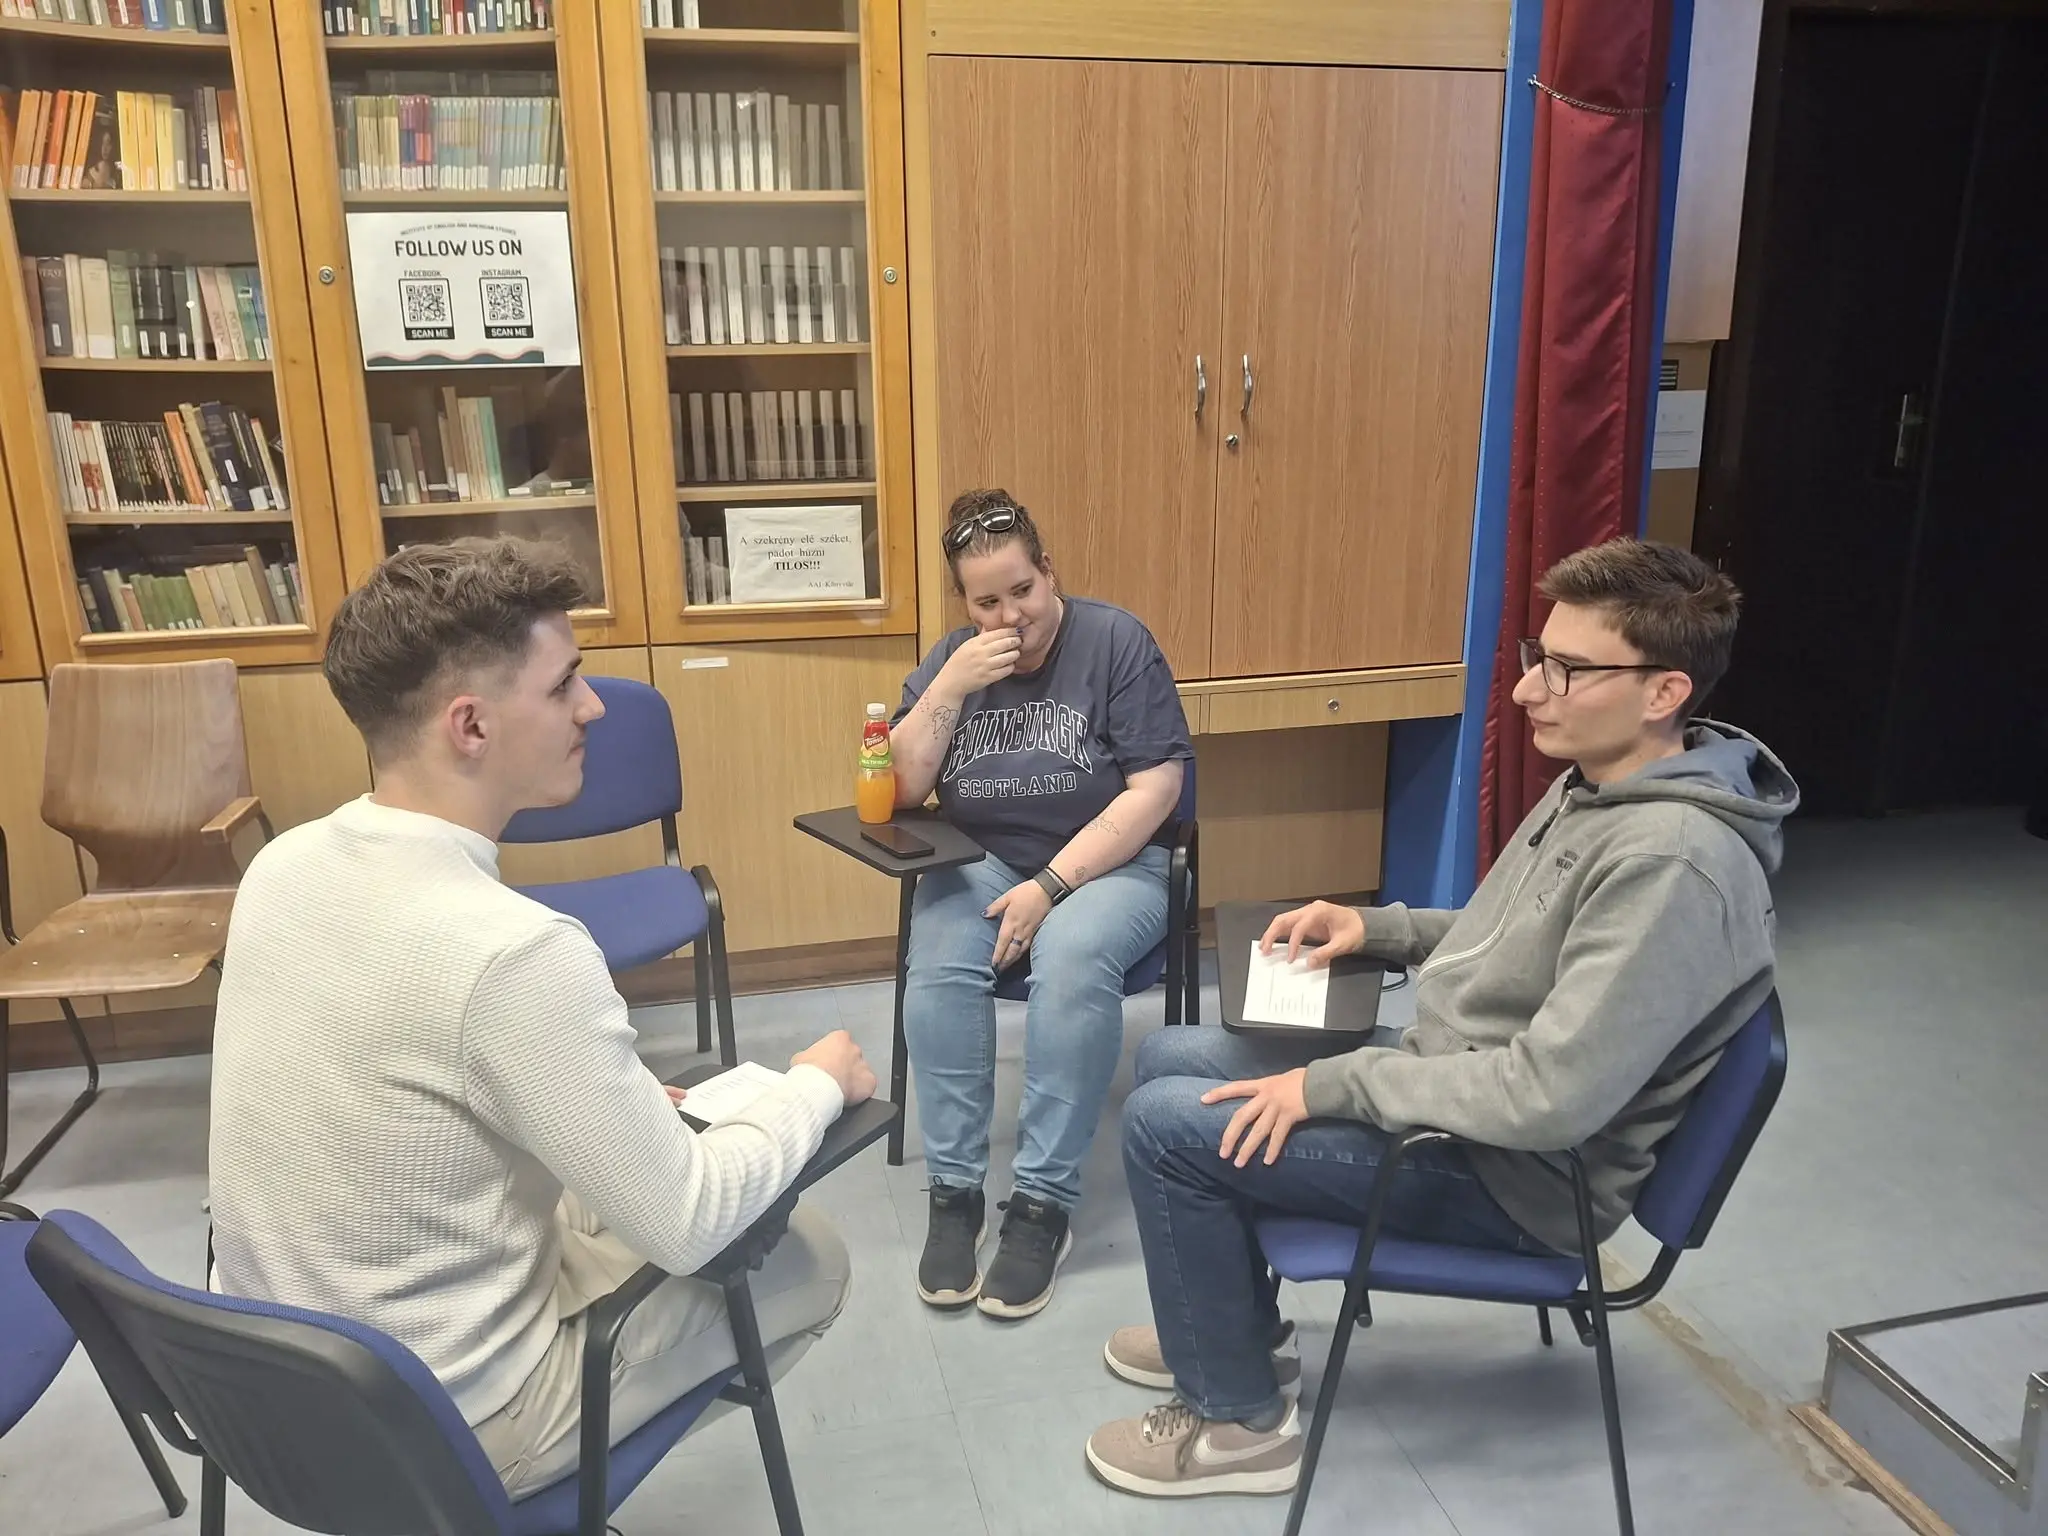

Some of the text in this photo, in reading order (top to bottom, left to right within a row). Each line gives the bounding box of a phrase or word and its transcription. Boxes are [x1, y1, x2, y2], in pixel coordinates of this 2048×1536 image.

[394, 239, 523, 257] FOLLOW US ON
[411, 329, 449, 338] SCAN ME
[491, 328, 528, 337] SCAN ME
[740, 536, 748, 545] A
[753, 536, 796, 546] szekrény
[774, 560, 821, 571] TILOS!!!
[943, 698, 1093, 783] EDINBURGH
[958, 771, 1077, 798] SCOTLAND
